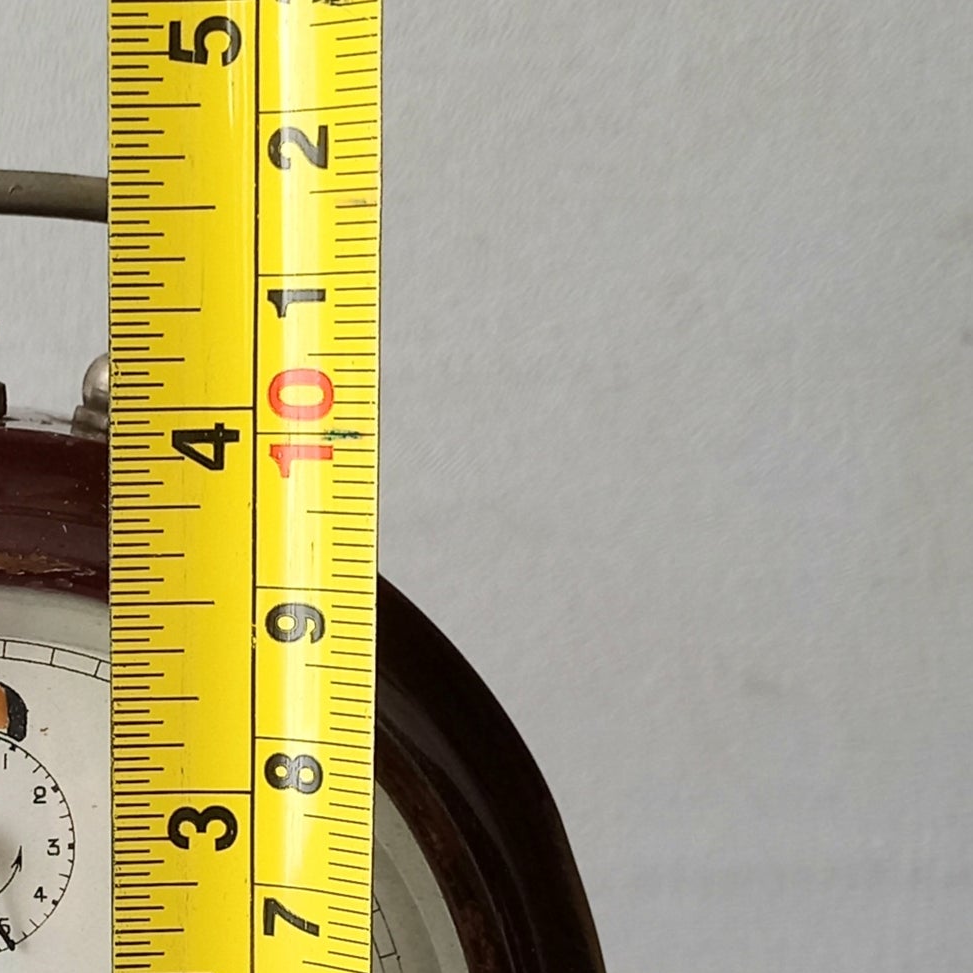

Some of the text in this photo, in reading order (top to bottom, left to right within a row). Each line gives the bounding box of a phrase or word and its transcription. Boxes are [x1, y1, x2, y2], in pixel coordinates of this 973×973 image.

[169, 15, 242, 67] 5
[267, 125, 328, 170] 2
[267, 288, 326, 318] 1
[268, 368, 334, 478] 10
[172, 423, 240, 471] 4
[265, 602, 325, 643] 9
[2, 753, 8, 770] 1
[264, 752, 323, 795] 8
[32, 786, 47, 804] 2
[46, 838, 61, 855] 3
[167, 805, 238, 851] 3
[33, 886, 47, 902] 4
[263, 897, 320, 937] 7
